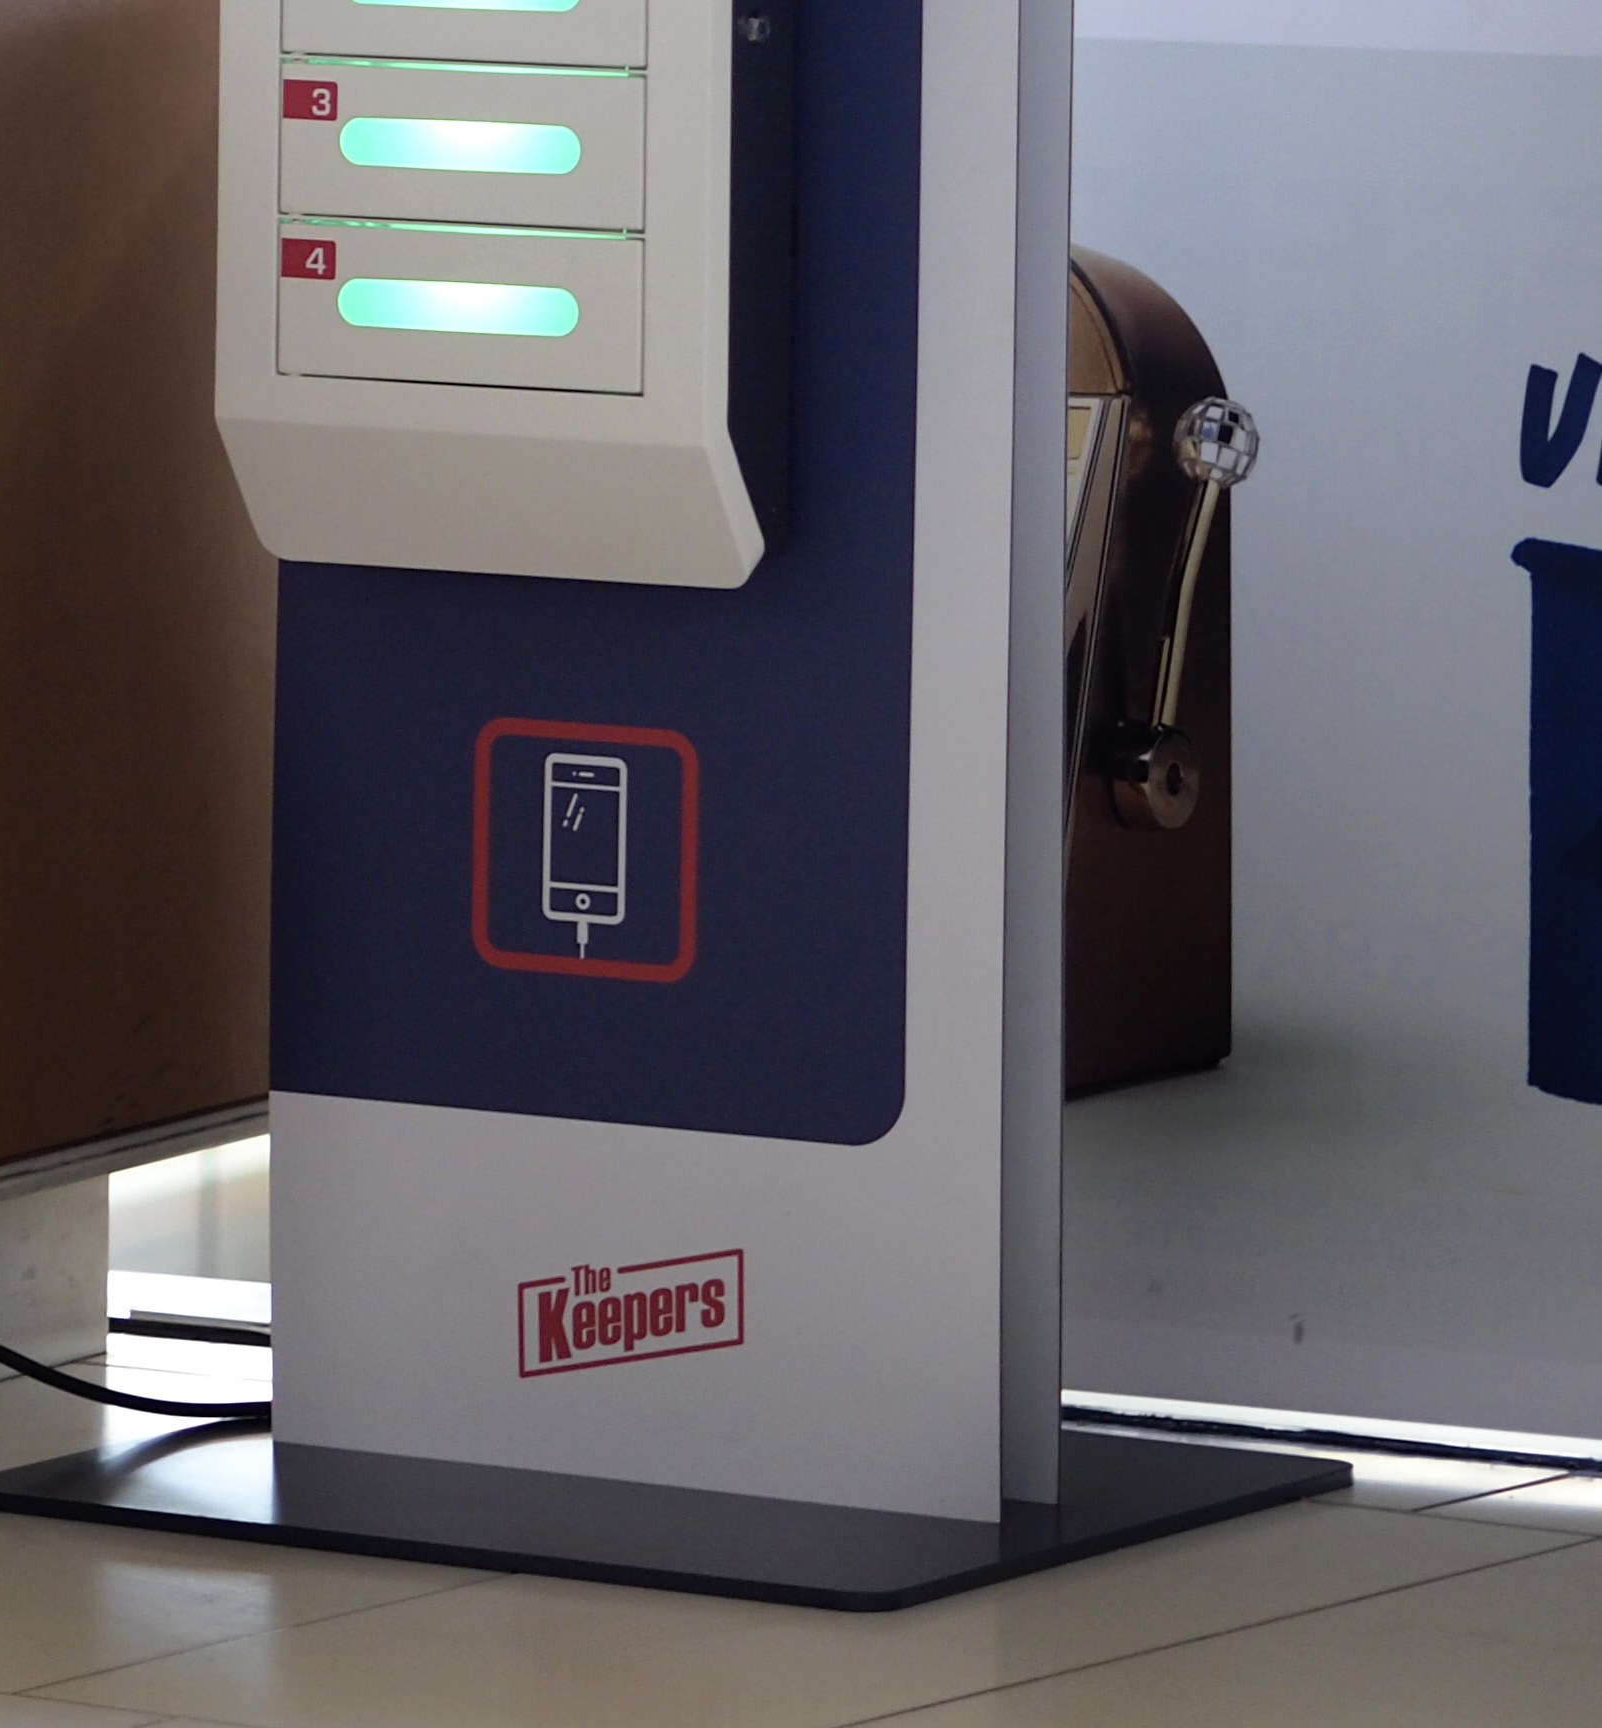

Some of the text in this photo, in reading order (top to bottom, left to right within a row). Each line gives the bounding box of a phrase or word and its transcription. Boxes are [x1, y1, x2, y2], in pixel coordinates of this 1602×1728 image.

[310, 87, 332, 118] 3
[304, 247, 328, 276] 4
[570, 1263, 612, 1296] The
[538, 1277, 727, 1364] Keepers
